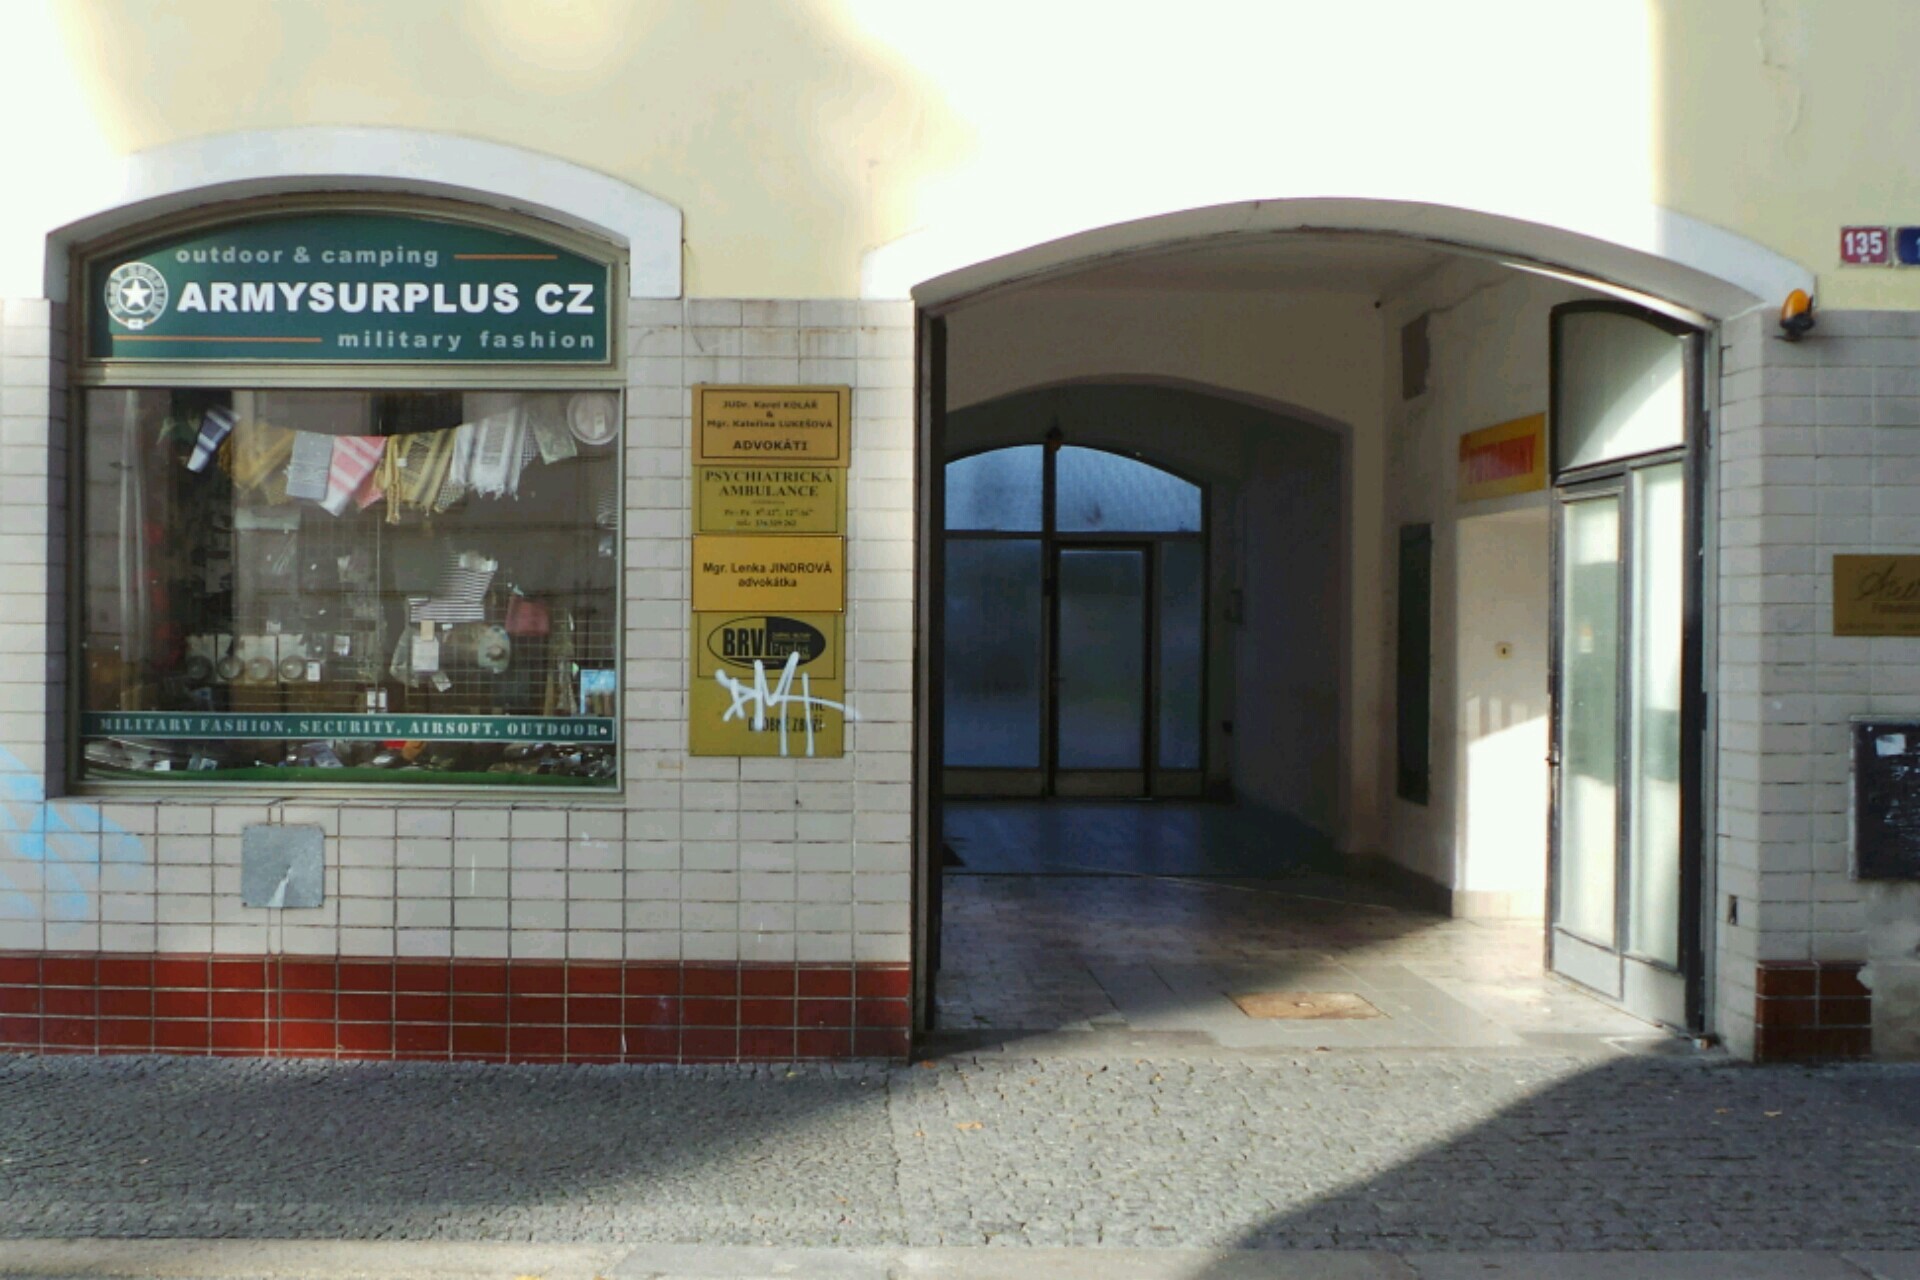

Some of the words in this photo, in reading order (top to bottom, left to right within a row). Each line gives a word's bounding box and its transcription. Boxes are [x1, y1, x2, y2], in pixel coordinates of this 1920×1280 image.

[1844, 231, 1883, 256] 135
[175, 246, 283, 264] outdoor
[293, 246, 310, 264] &
[320, 246, 439, 268] camping
[176, 281, 520, 315] ARMYSURPLUS
[534, 282, 595, 315] CZ
[337, 330, 463, 351] military
[479, 330, 595, 349] fashion
[732, 438, 808, 451] ADVOKÁTI
[705, 469, 833, 483] PSYCHIATRICKÁ
[719, 485, 819, 497] AMBULANCE
[702, 562, 728, 575] Mgr.
[731, 562, 766, 573] Lenka
[737, 576, 797, 588] advokátka
[722, 627, 764, 657] BRV
[100, 717, 193, 731] MILITARY
[199, 718, 292, 734] FASHION,
[299, 720, 402, 736] SECURITY,
[408, 721, 500, 737] AIRSOFT,
